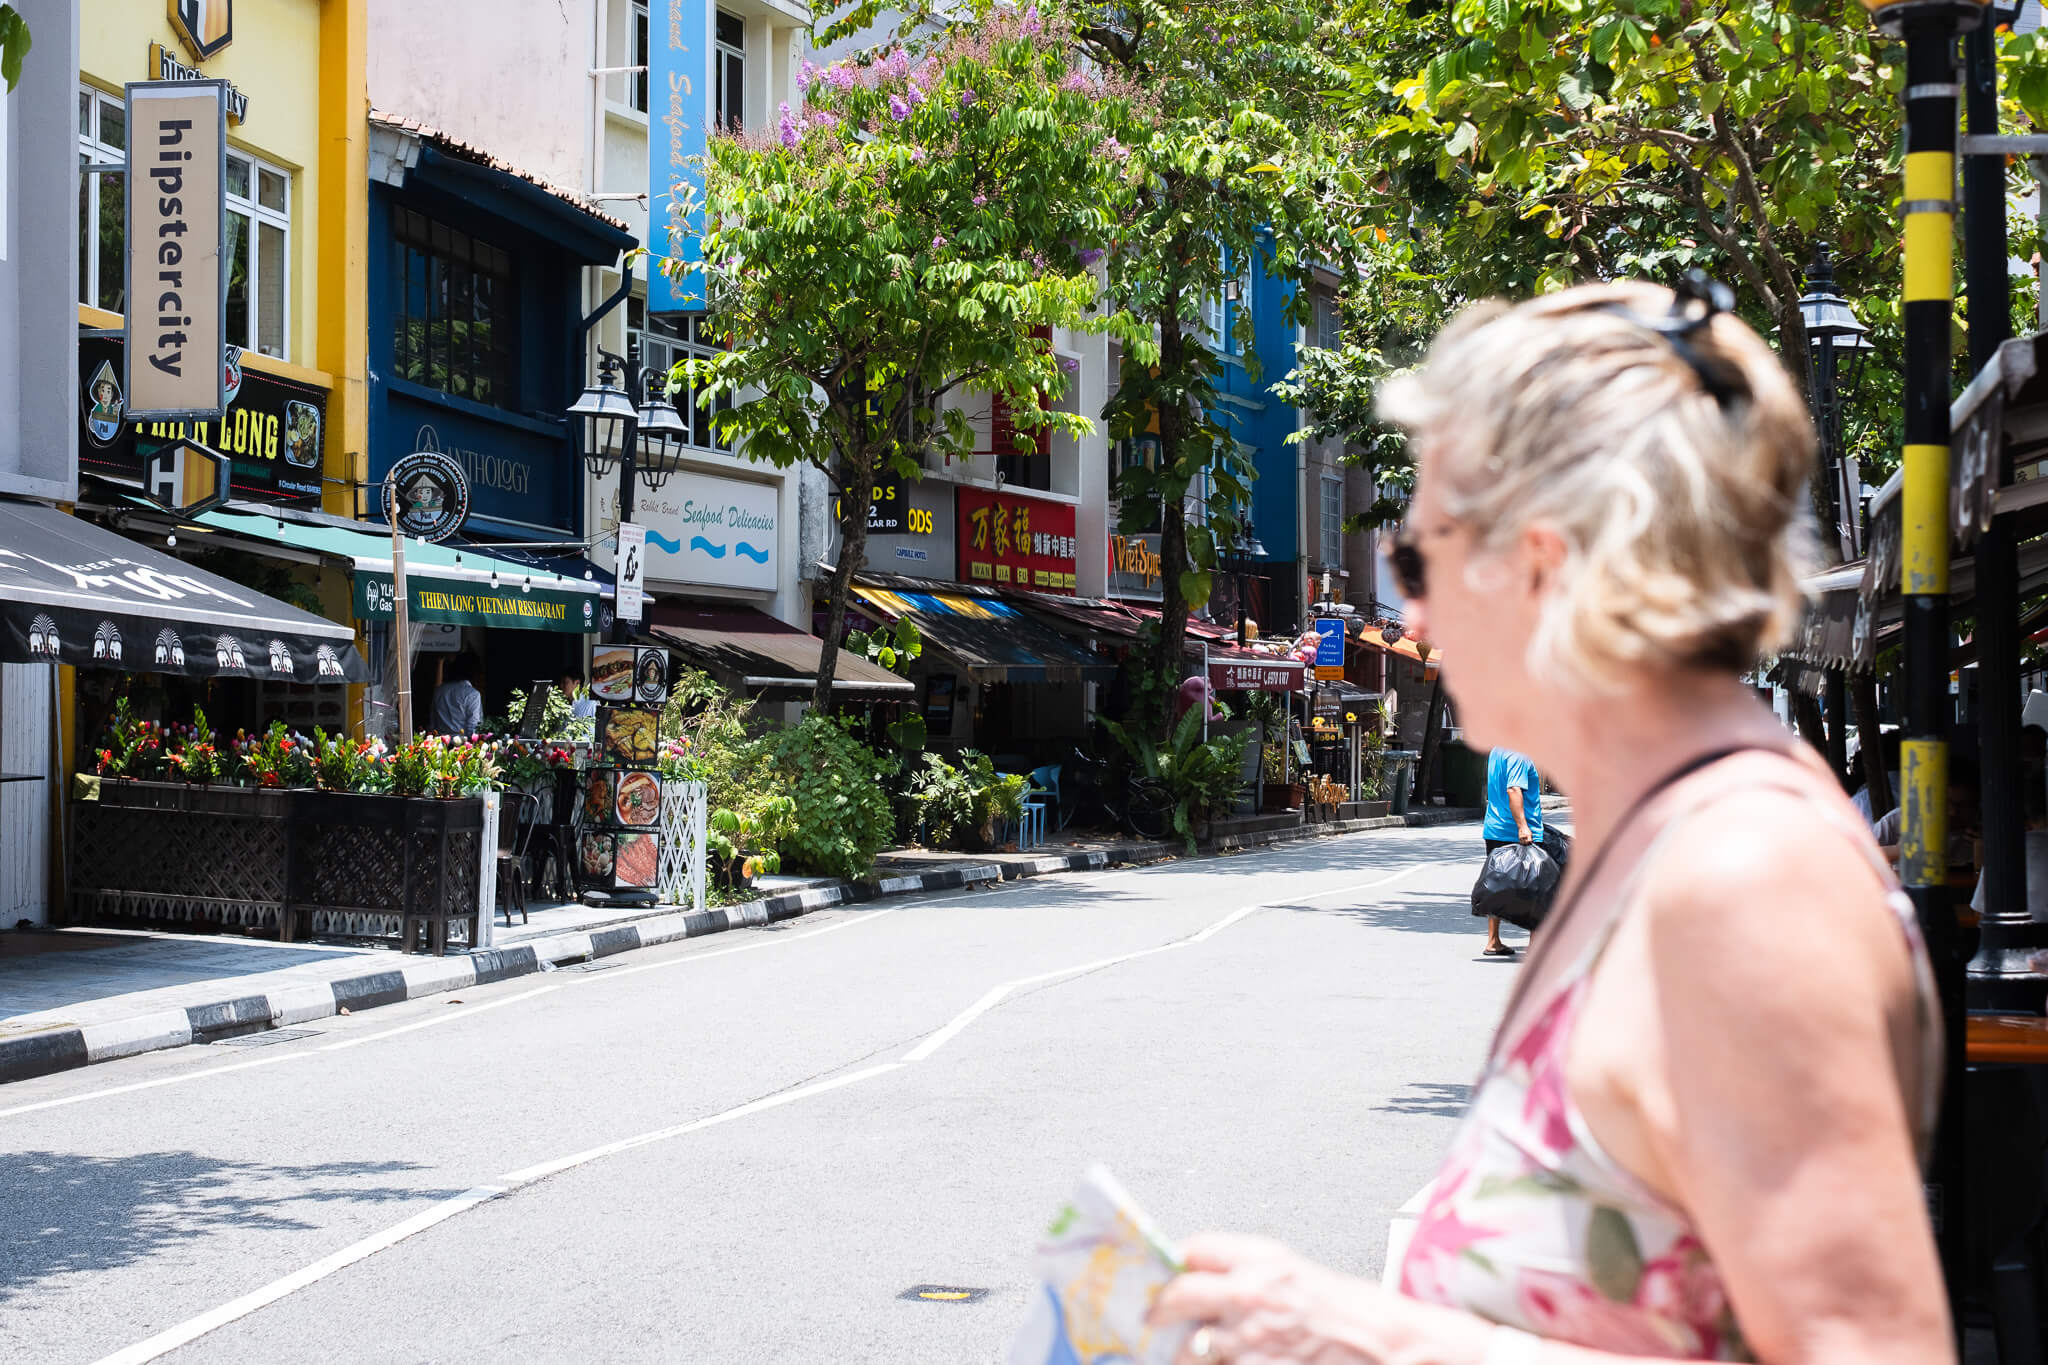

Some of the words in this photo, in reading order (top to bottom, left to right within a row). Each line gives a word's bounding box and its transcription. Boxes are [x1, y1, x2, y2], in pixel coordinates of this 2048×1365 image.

[662, 71, 692, 168] Seafood
[149, 119, 193, 378] hipstercity
[219, 408, 279, 460] LONG
[640, 499, 659, 513] Rabbit
[661, 502, 680, 516] Brand
[682, 500, 725, 531] Seafood
[728, 505, 775, 531] Delicacies
[886, 518, 898, 528] RD
[971, 502, 1031, 557] 万家福
[914, 551, 927, 560] HOTEL
[975, 565, 990, 577] WAN
[999, 568, 1009, 579] JIA
[1019, 570, 1027, 581] FU
[380, 583, 394, 597] YLH
[379, 598, 393, 612] Gas
[419, 591, 450, 610] THIEN
[450, 593, 475, 613] LONG
[476, 596, 518, 616] VIETNAM
[517, 600, 567, 620] RESTAURANT
